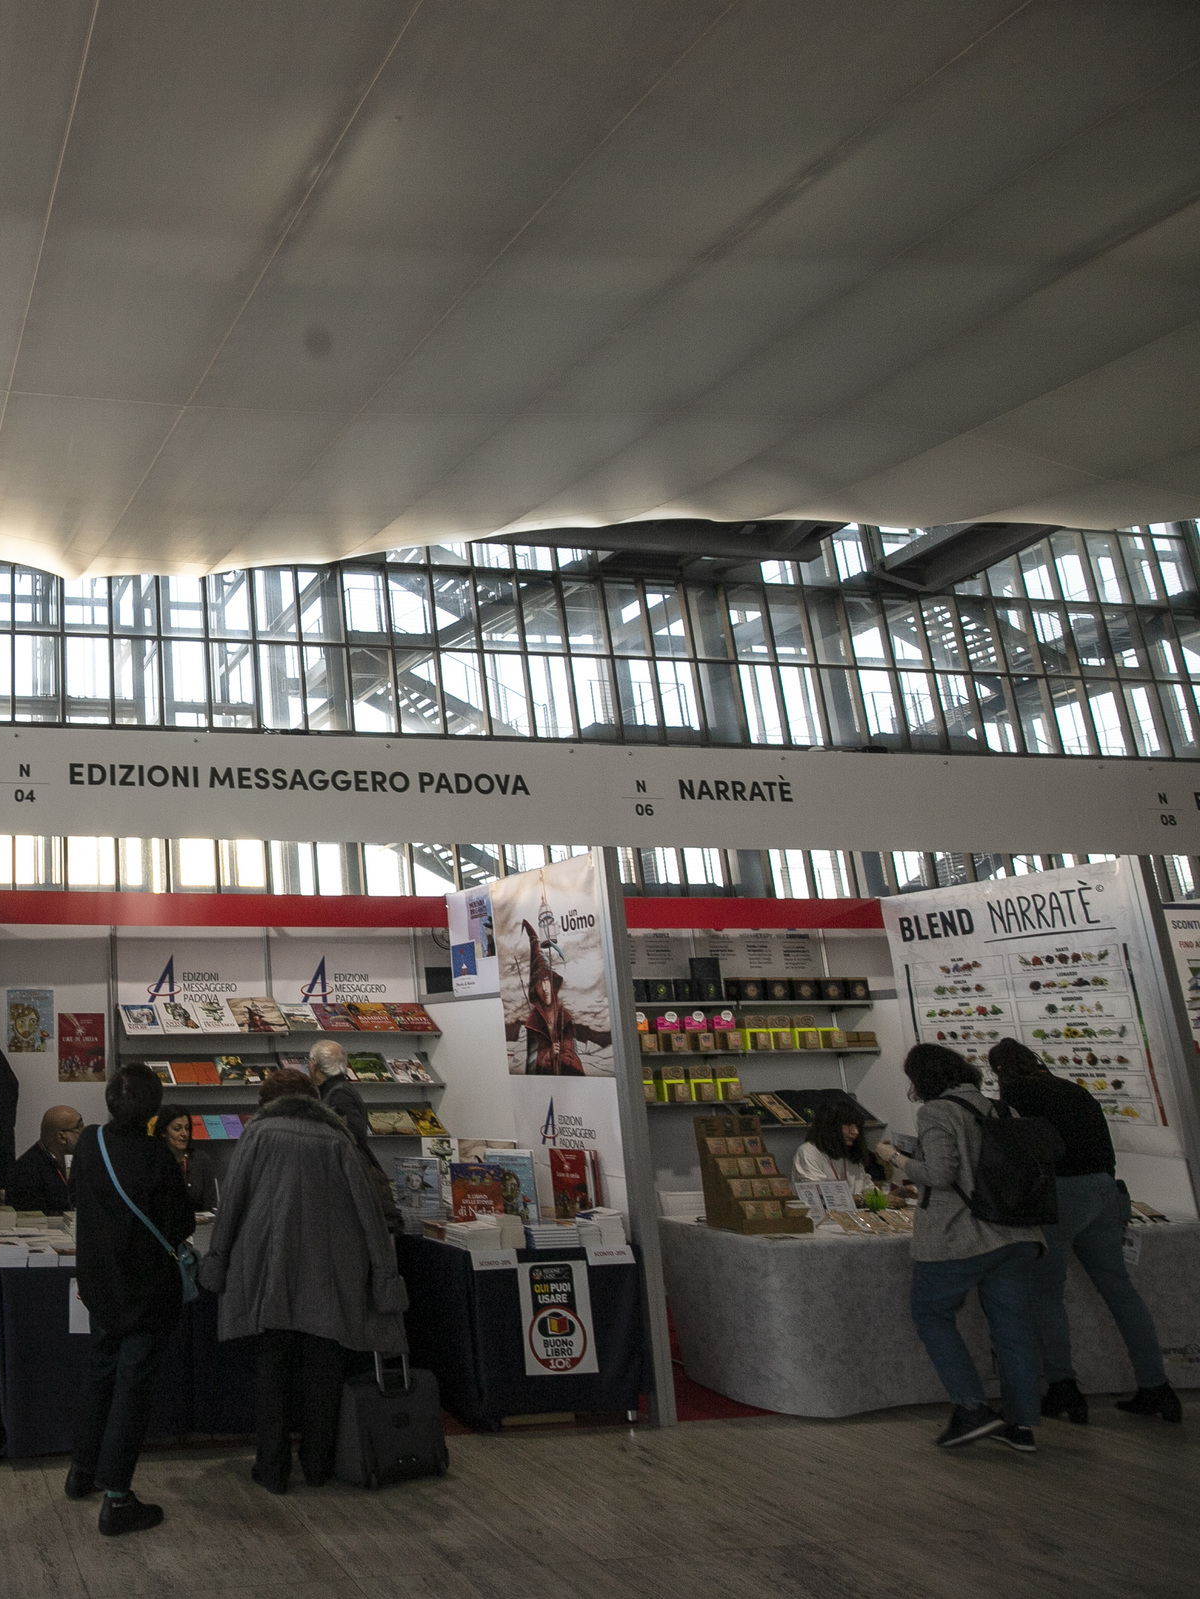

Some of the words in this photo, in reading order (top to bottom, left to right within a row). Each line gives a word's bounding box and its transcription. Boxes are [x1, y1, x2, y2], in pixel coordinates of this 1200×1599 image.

[19, 763, 31, 778] N
[68, 762, 200, 789] EDIZIONI
[208, 766, 411, 794] MESSAGGERO
[417, 771, 531, 797] PADOVA
[635, 779, 647, 793] N
[677, 774, 794, 803] NARRATÈ
[14, 789, 36, 803] 04
[1157, 791, 1168, 805] N
[635, 803, 654, 817] 06
[1160, 814, 1177, 826] 08
[898, 908, 975, 943] BLEND
[986, 879, 1100, 934] NARRATÈ
[560, 914, 595, 932] Uomo
[182, 972, 220, 982] EDIZIONI
[334, 973, 369, 983] EDIZIONI
[183, 982, 238, 993] MESSAGGERO
[334, 983, 387, 994] MESSAGGERO
[183, 993, 220, 1003] PADOVA
[335, 994, 370, 1003] PADOVA
[533, 1283, 549, 1294] QUI
[550, 1282, 572, 1293] PUOI
[538, 1293, 569, 1304] USARE
[545, 1347, 573, 1358] LIBRO
